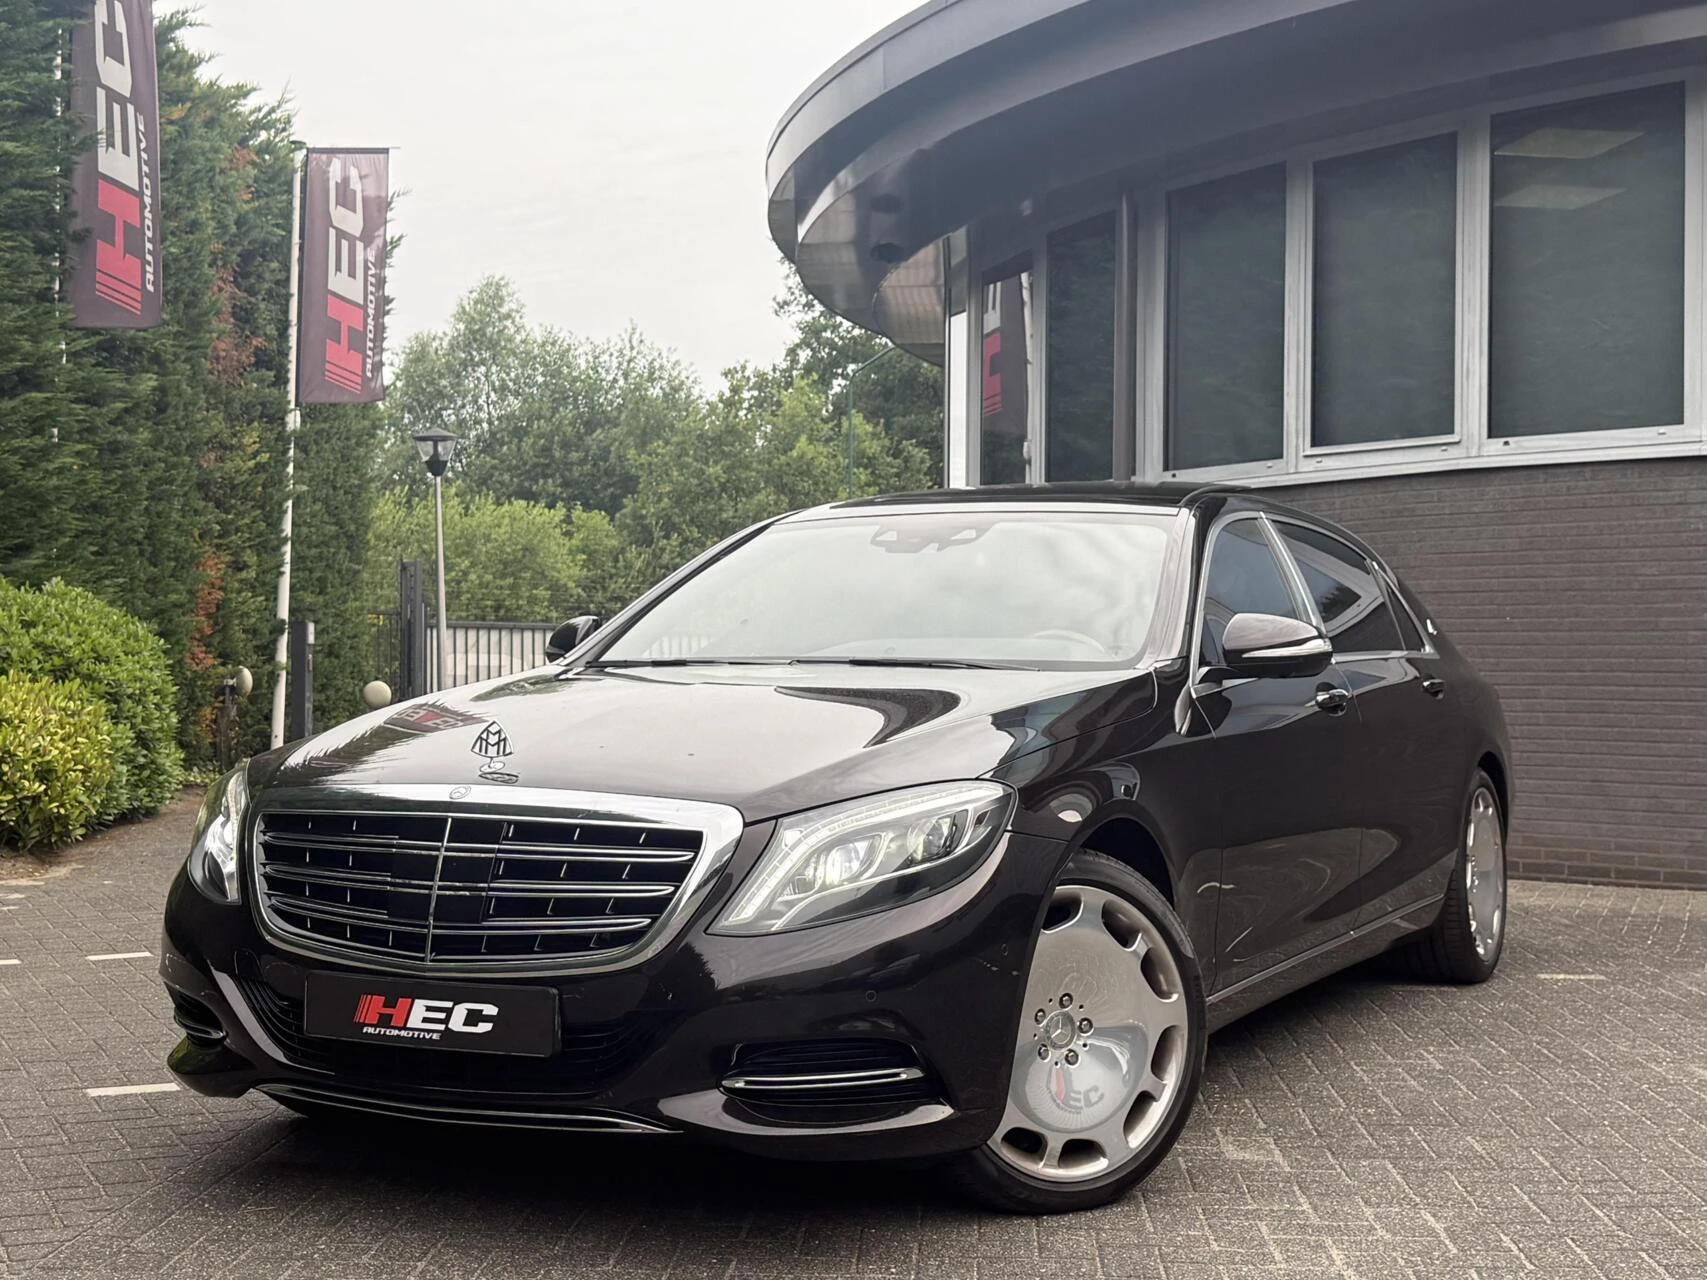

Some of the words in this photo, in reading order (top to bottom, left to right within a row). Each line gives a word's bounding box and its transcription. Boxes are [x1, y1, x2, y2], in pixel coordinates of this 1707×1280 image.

[95, 0, 141, 315] HEC
[136, 112, 154, 293] AUTOMOTIVE
[325, 157, 364, 394] HEC
[365, 247, 377, 379] AUTOMOTIVE
[355, 995, 499, 1033] HEC
[362, 1027, 441, 1040] AUTOMOTIVE
